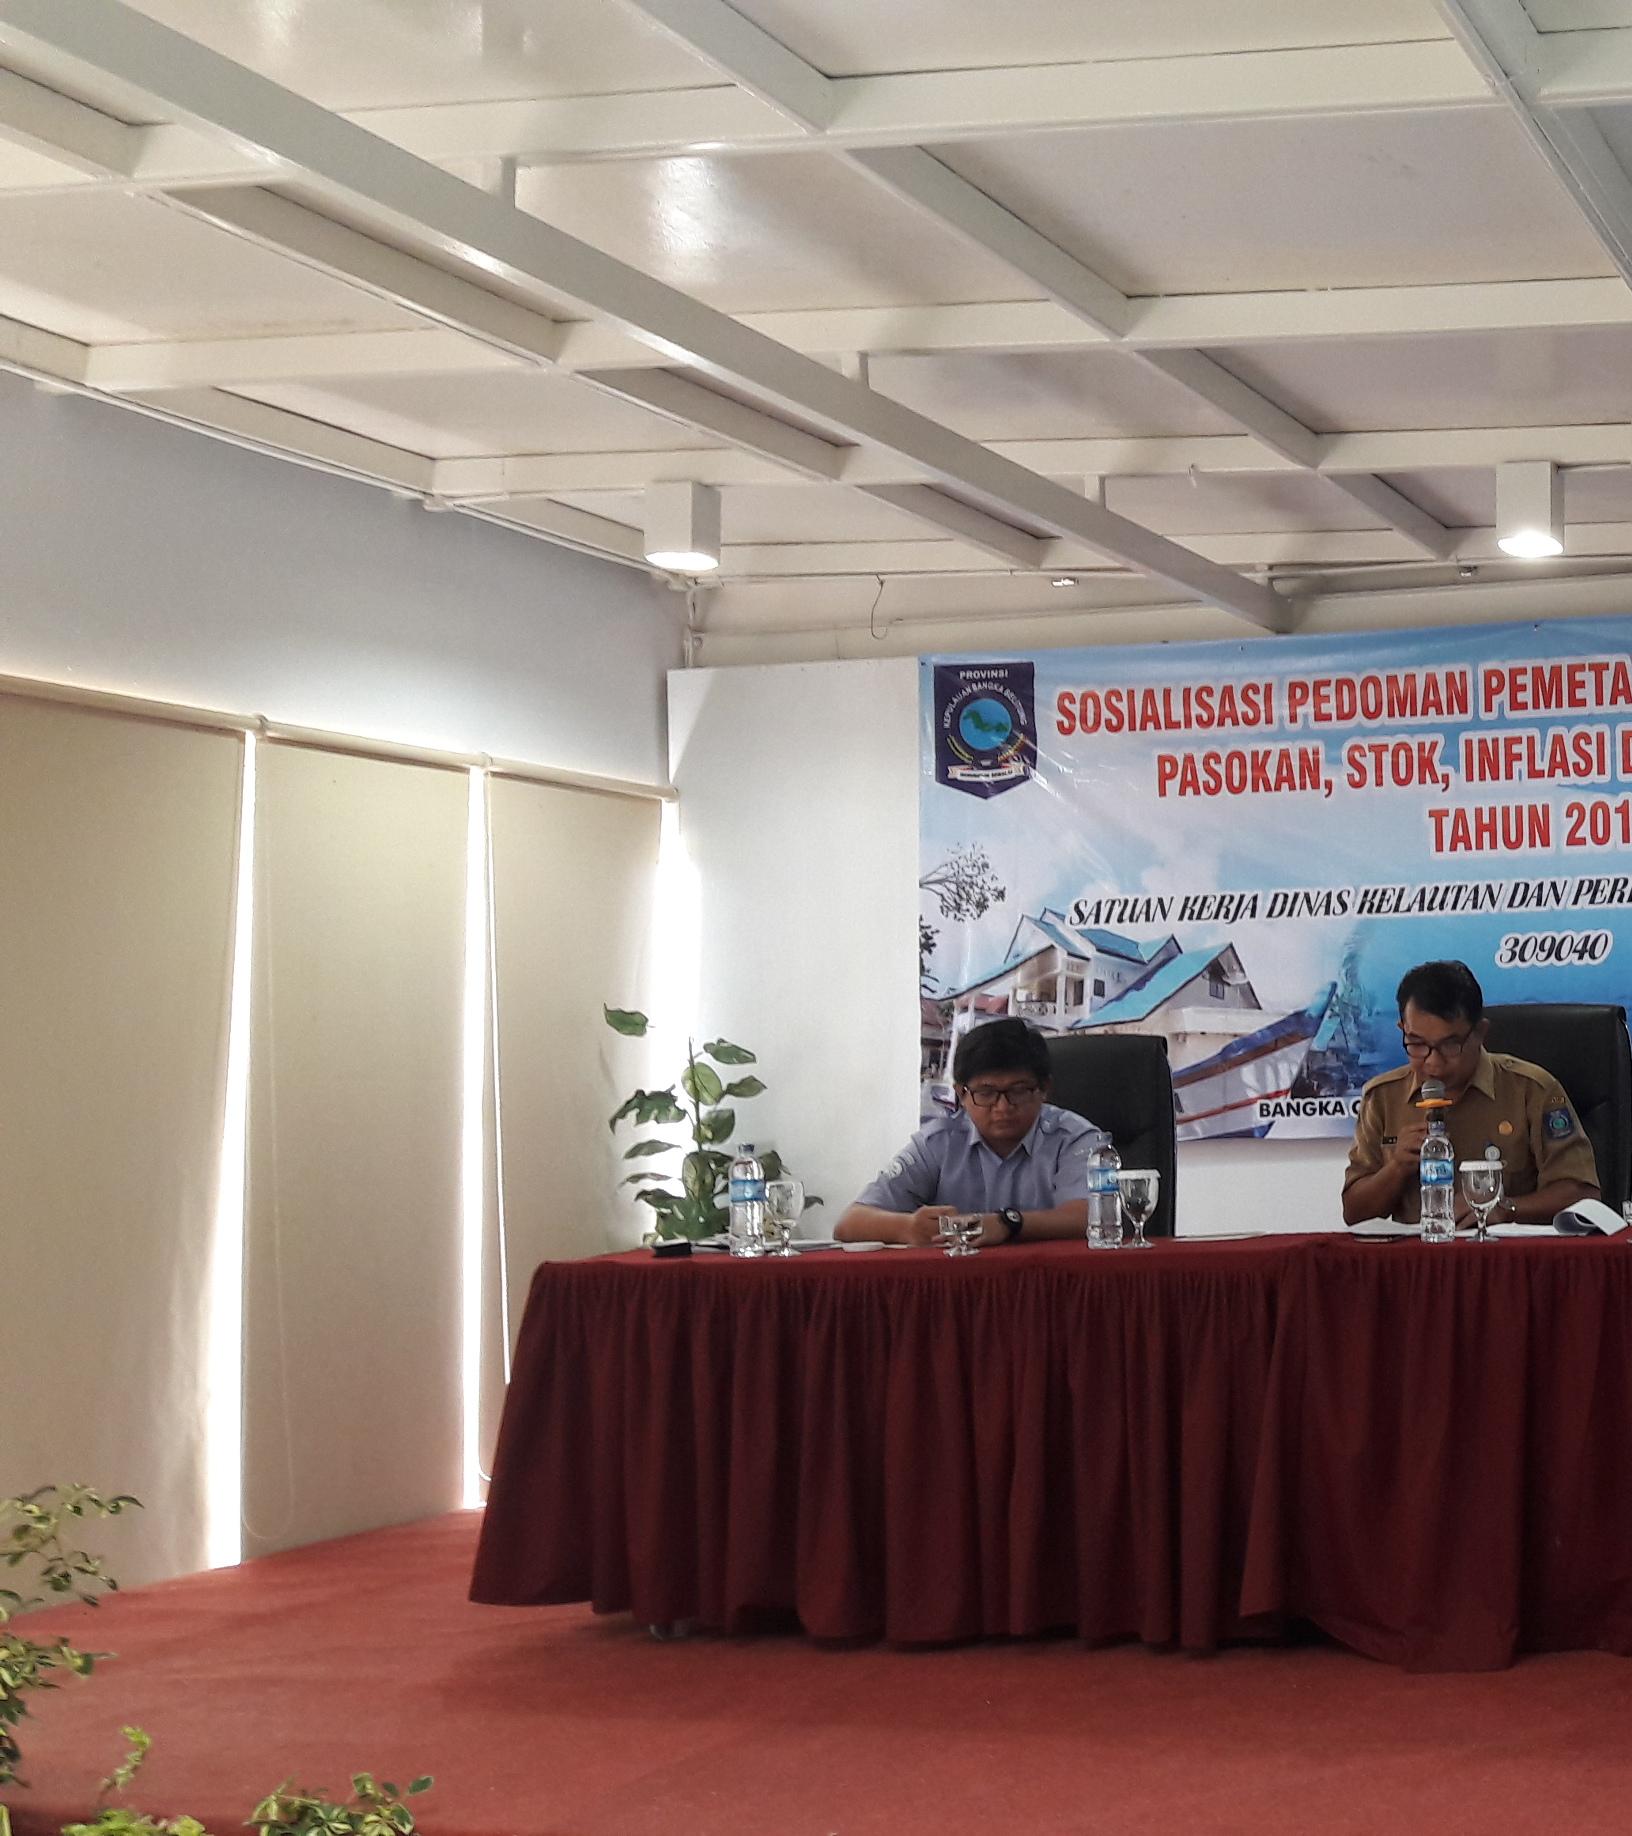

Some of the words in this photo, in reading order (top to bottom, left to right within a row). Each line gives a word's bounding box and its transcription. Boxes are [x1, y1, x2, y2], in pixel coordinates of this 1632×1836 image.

[959, 669, 1009, 680] PROVINSI
[1056, 681, 1275, 736] SOSIALISASI
[1287, 669, 1469, 725] PEDOMAN
[1157, 748, 1333, 799] PASOKAN,
[1346, 740, 1451, 792] STOK,
[1463, 730, 1607, 783] INFLASI
[1429, 802, 1552, 854] TAHUN
[1068, 896, 1175, 927] SATUAN
[1177, 892, 1259, 925] KERJA
[1266, 889, 1352, 920] DINAS
[1357, 882, 1504, 915] KELAUTAN
[1506, 879, 1570, 909] DAN
[1498, 933, 1611, 965] 309040
[1258, 1099, 1347, 1119] BANGKA
